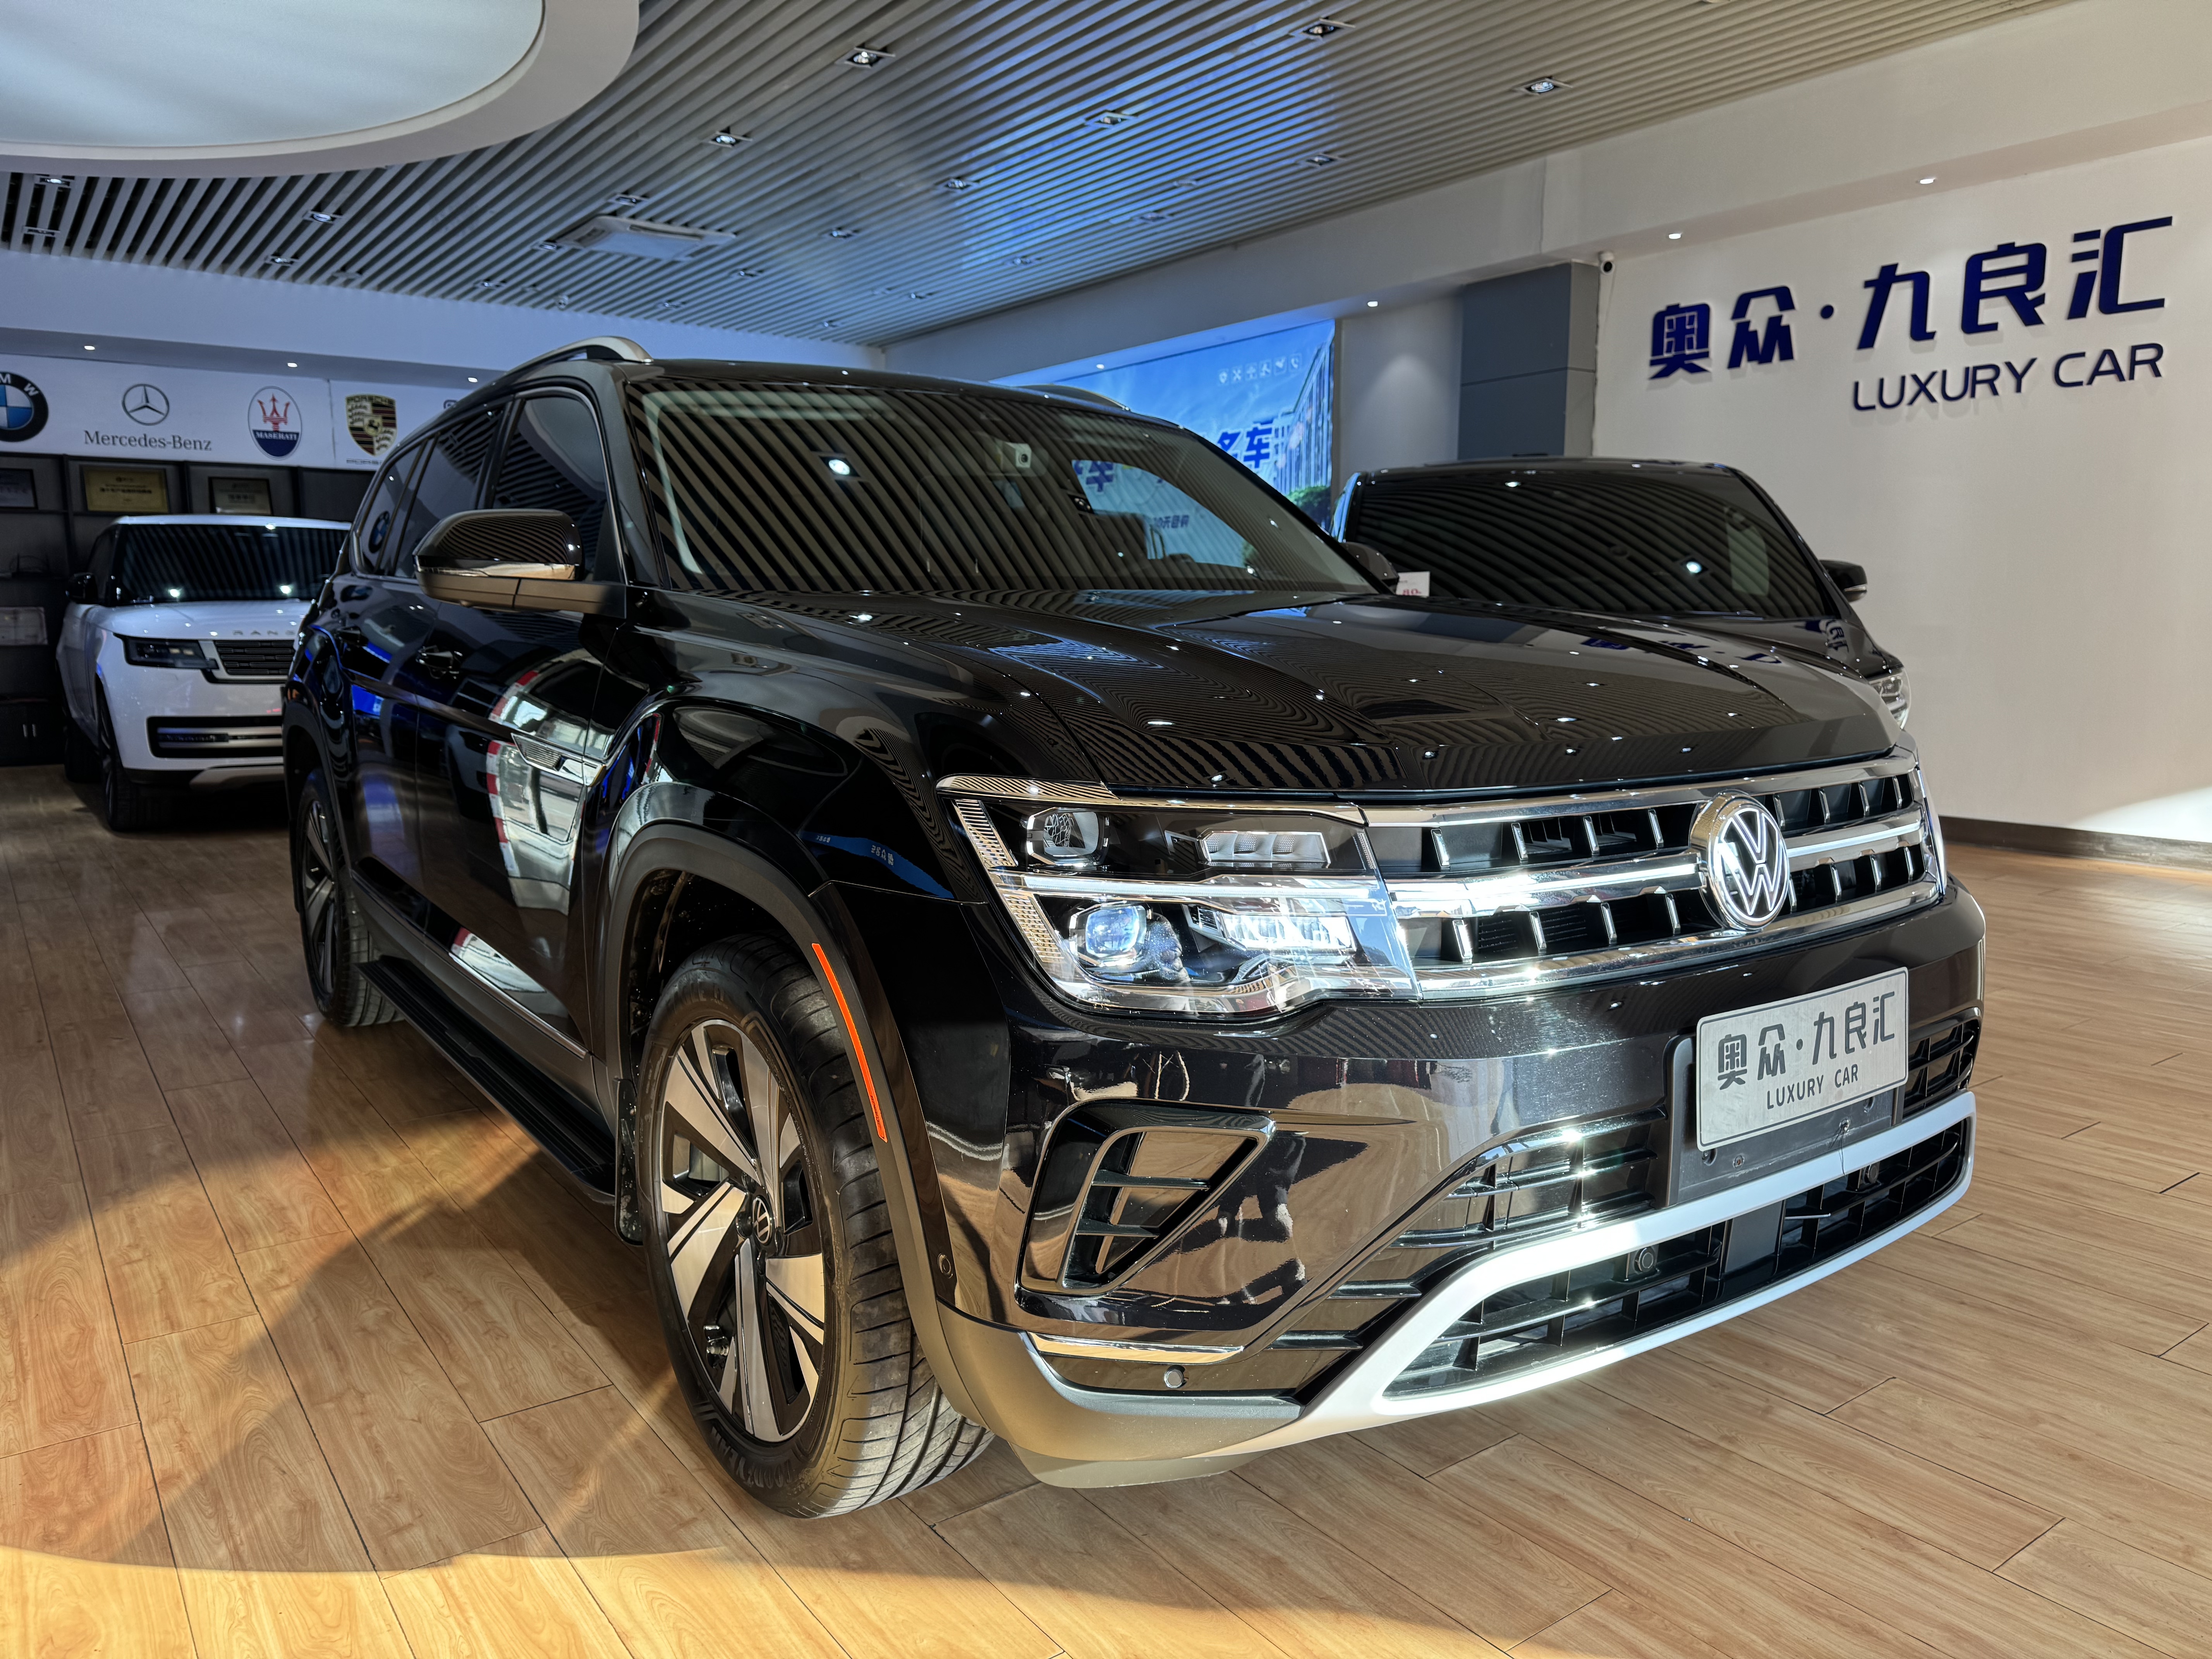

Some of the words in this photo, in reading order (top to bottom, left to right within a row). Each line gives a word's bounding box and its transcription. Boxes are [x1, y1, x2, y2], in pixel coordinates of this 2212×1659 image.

[1649, 215, 2173, 380] 奥众·九良汇
[1852, 357, 2038, 412] LUXURY
[2053, 342, 2166, 388] CAR
[84, 430, 212, 451] Mercedes-Benz
[255, 431, 297, 441] MASERATI
[1718, 991, 1895, 1090] 奥众·九良汇
[1767, 1074, 1824, 1110] LUXURY
[1834, 1064, 1858, 1089] CAR
